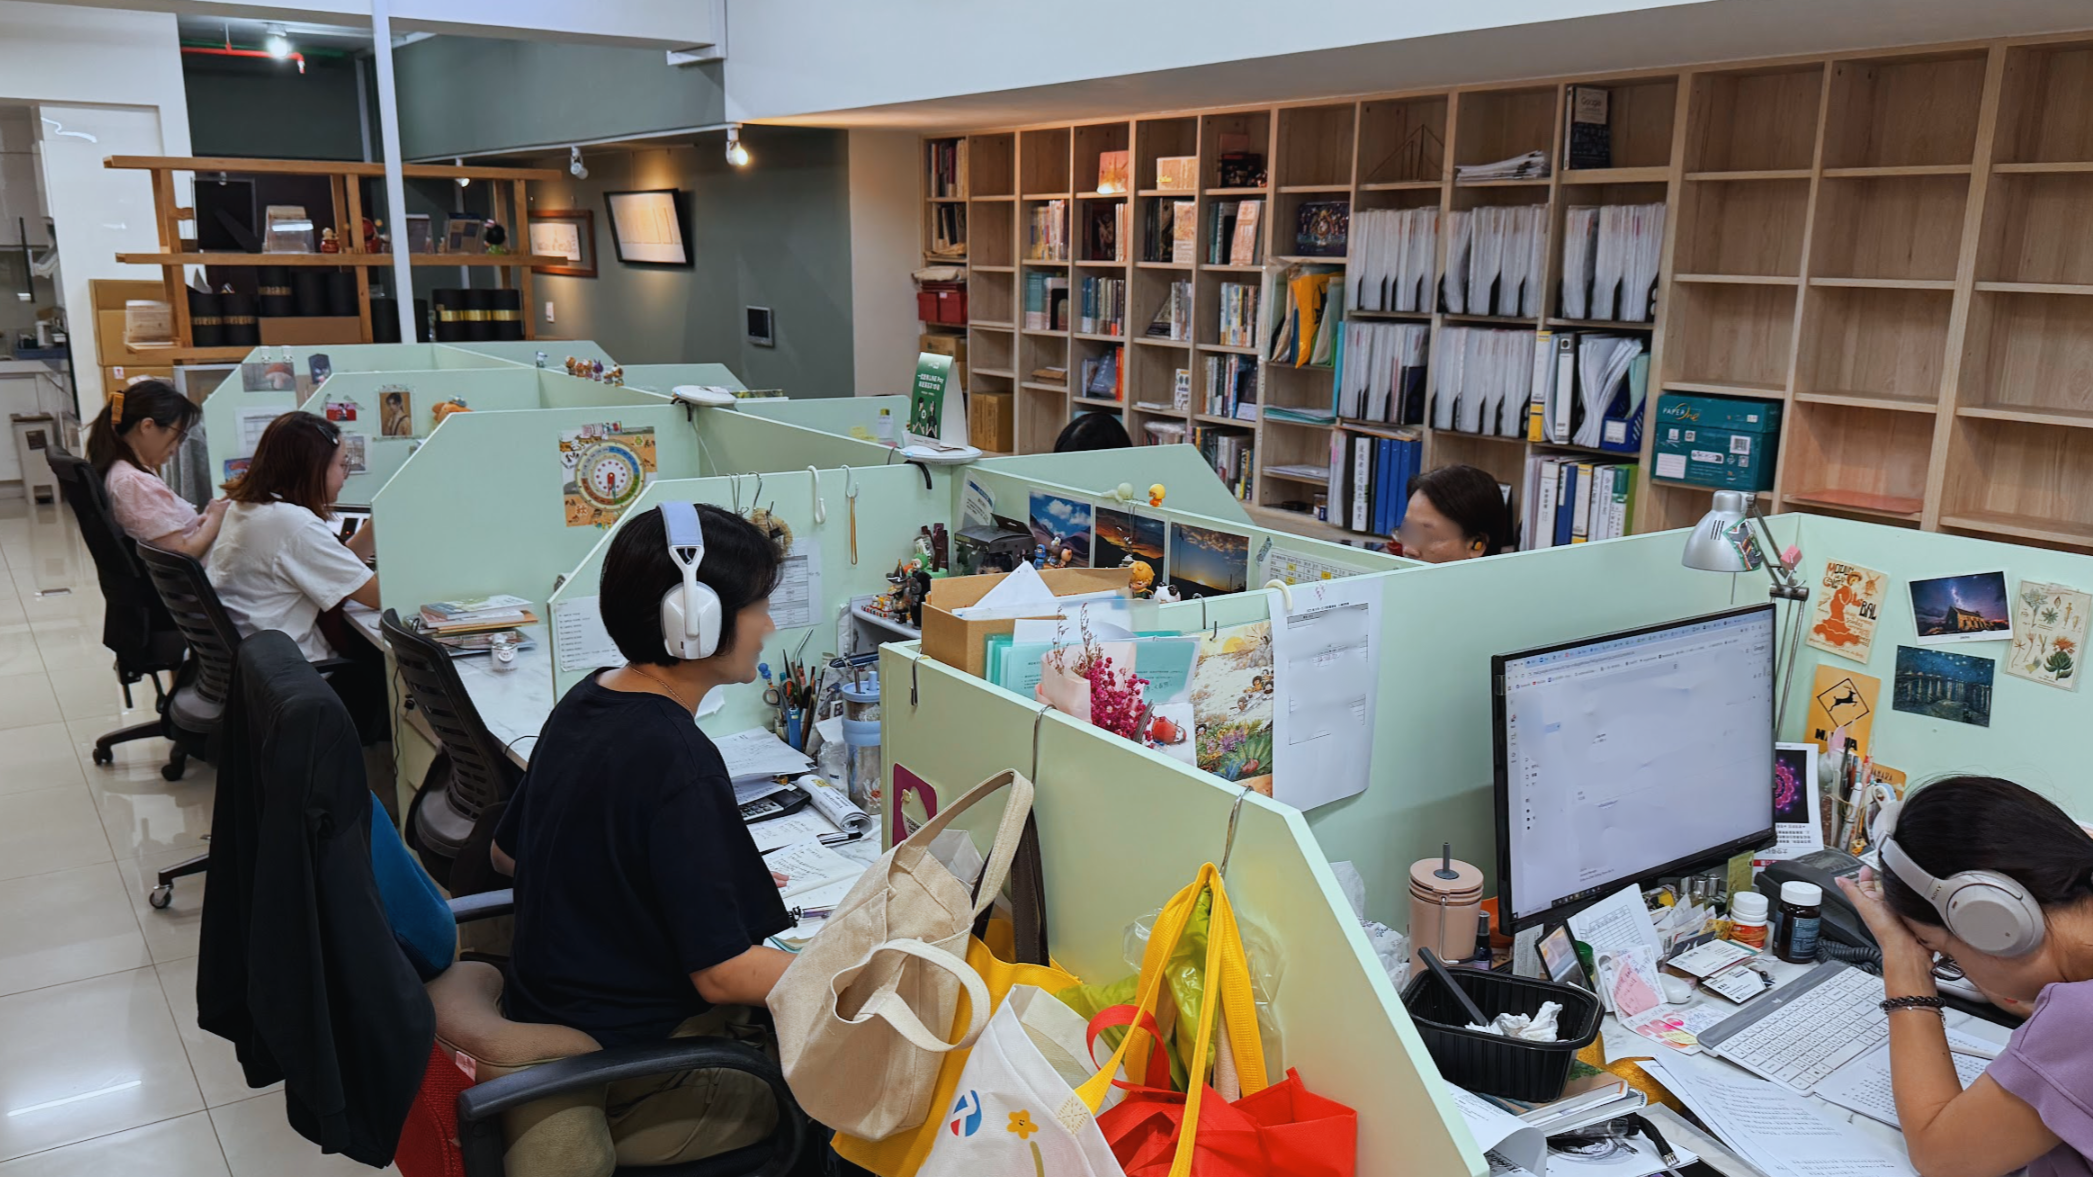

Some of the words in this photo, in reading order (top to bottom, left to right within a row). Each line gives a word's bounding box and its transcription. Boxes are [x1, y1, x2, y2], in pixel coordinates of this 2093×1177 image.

[1662, 406, 1686, 416] PAPER
[1859, 600, 1877, 620] BAL
[1930, 884, 1942, 900] SONY
